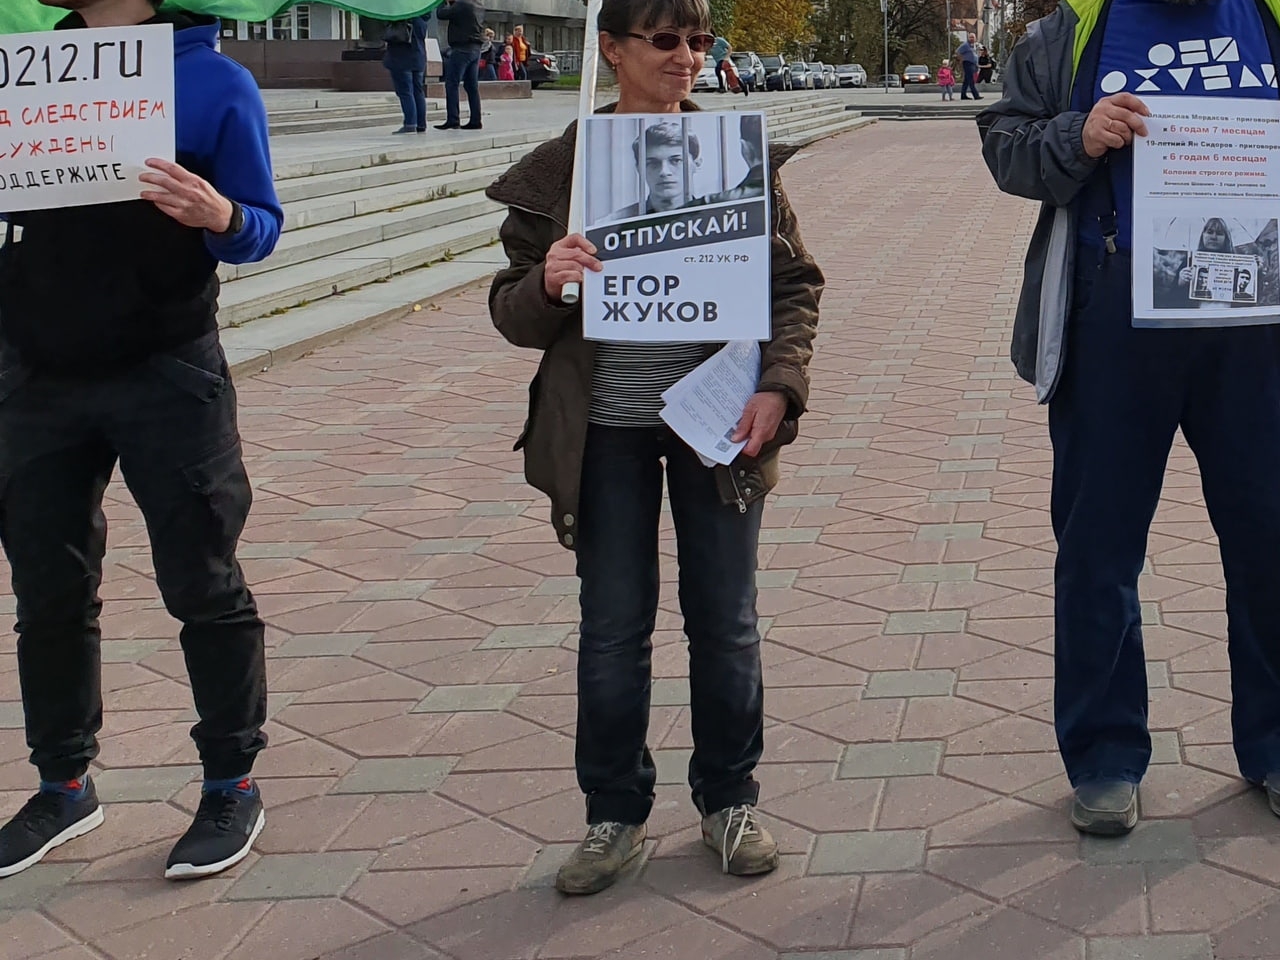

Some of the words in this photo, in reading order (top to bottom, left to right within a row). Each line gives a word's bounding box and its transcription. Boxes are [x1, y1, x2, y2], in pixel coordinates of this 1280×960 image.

[21, 99, 166, 126] СЛЕДСТВИЕМ
[1179, 126, 1210, 134] годам
[1212, 126, 1219, 134] 7
[1222, 127, 1266, 136] месяцам
[1200, 140, 1233, 149] Сидоров
[1169, 153, 1176, 161] 6
[1179, 155, 1210, 163] годам
[1222, 155, 1267, 163] месяцам
[1199, 170, 1233, 178] строгого
[604, 209, 748, 251] ОТПУСКАЙ!
[698, 254, 714, 263] 212
[716, 254, 731, 263] УК
[733, 254, 750, 263] РФ
[603, 275, 680, 296] ЕГОР
[602, 301, 718, 322] ЖУКОВ
